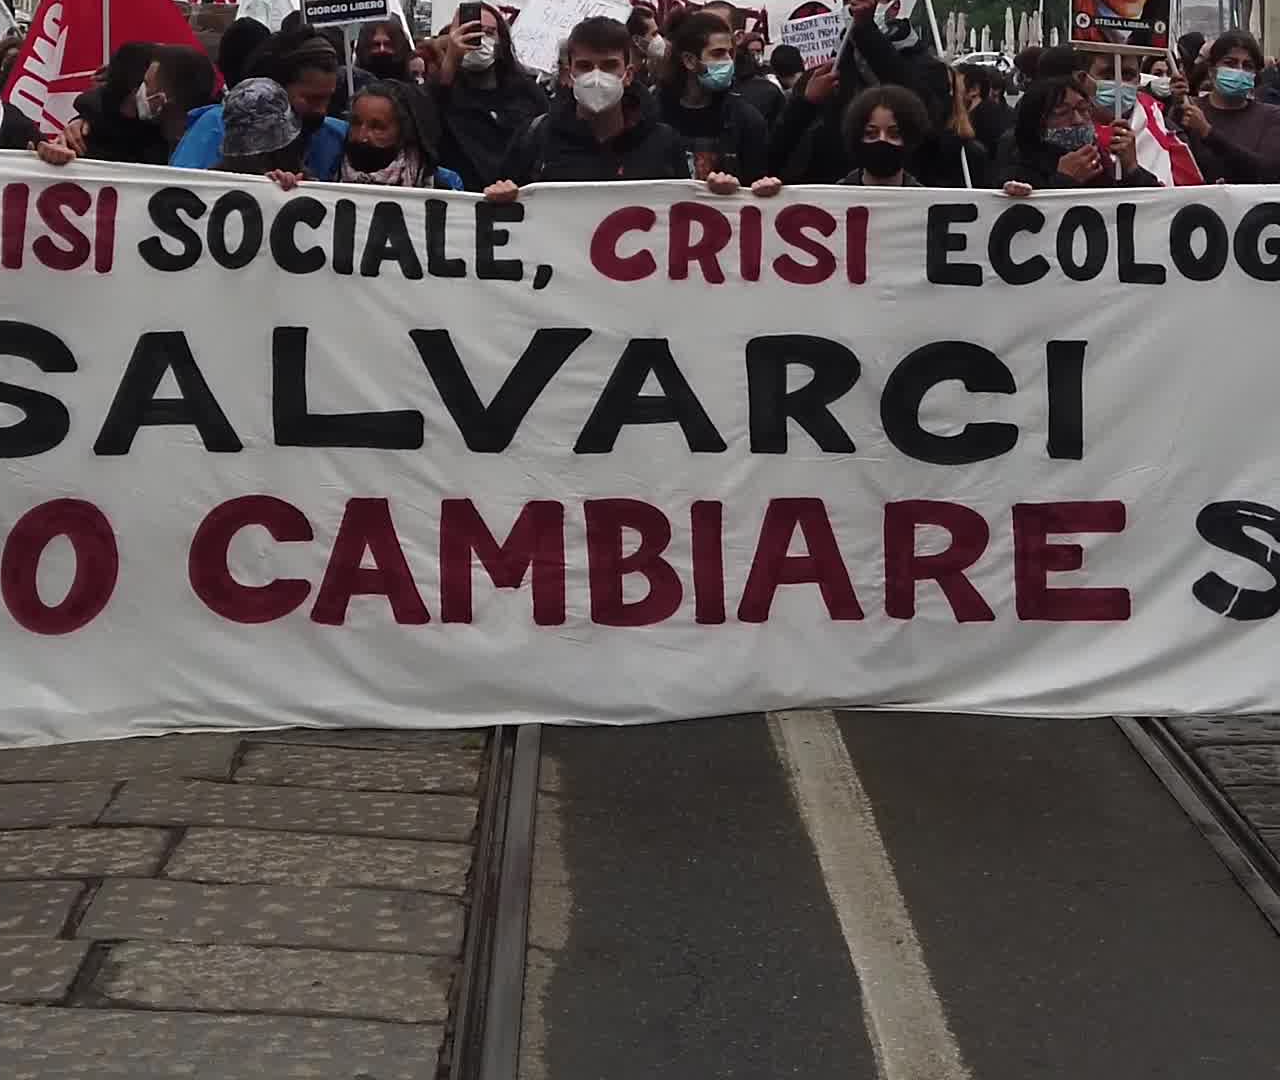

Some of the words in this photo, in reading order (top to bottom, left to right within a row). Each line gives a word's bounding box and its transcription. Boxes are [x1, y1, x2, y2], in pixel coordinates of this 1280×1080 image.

[306, 3, 348, 17] GIORGIO
[349, 0, 385, 12] LIBERO
[137, 186, 554, 290] SOCIALE,
[588, 201, 870, 285] CRISI
[188, 493, 1132, 627] CAMBIARE
